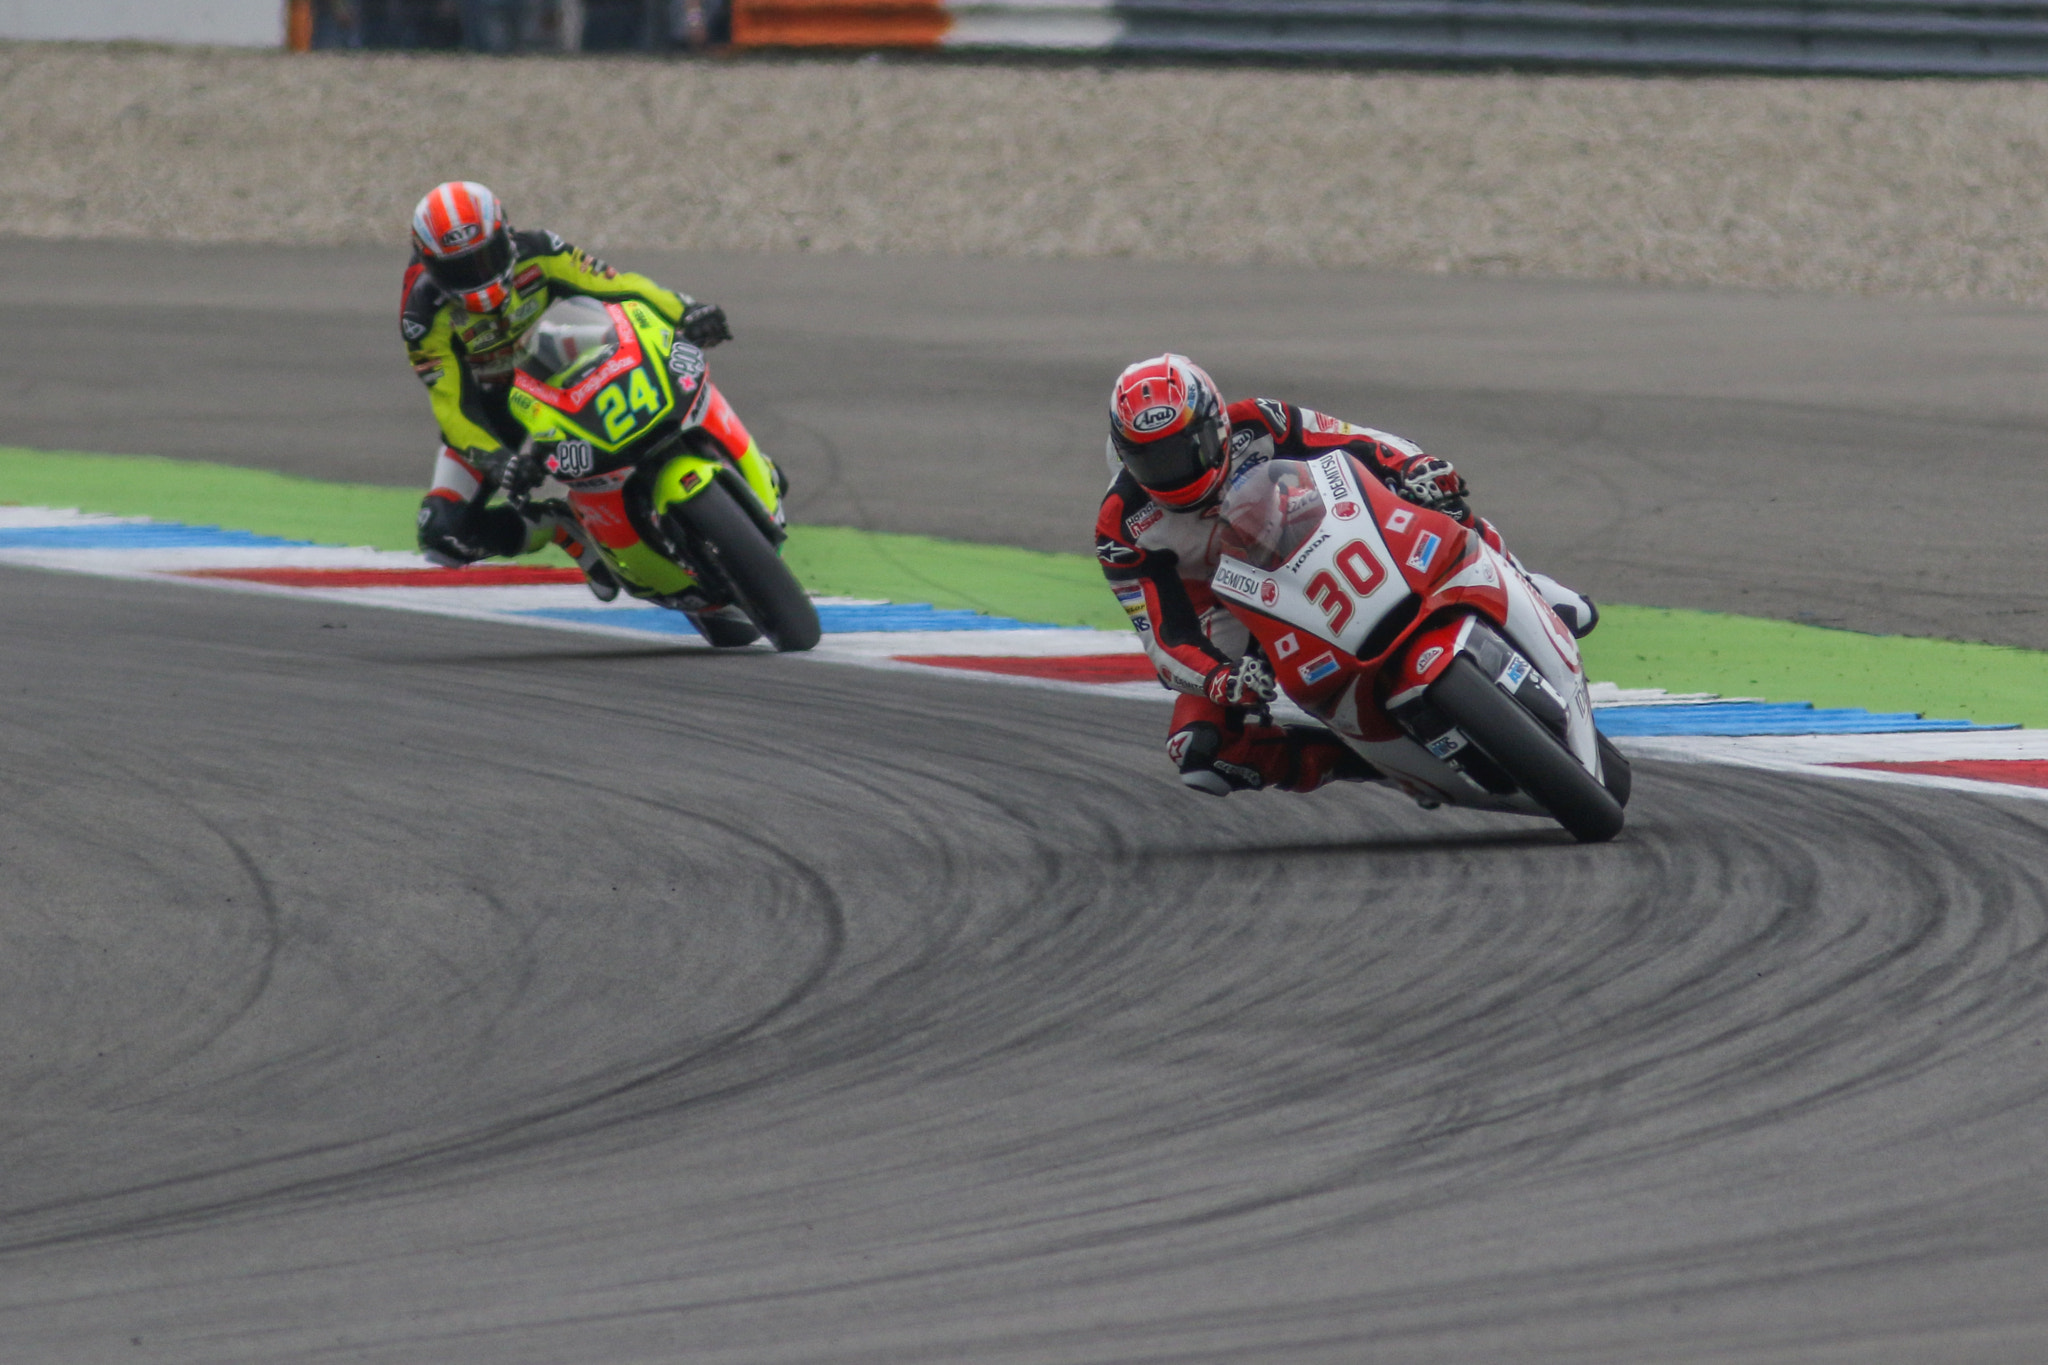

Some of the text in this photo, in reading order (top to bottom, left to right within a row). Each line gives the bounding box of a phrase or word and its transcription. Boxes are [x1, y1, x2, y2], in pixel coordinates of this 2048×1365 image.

[596, 366, 661, 442] 24
[1138, 408, 1172, 427] Arai
[558, 442, 591, 475] ego
[1321, 454, 1349, 500] IDEMITSU
[1291, 533, 1332, 574] HONDA
[1216, 566, 1260, 595] IDEMITSU
[1302, 538, 1388, 638] 30
